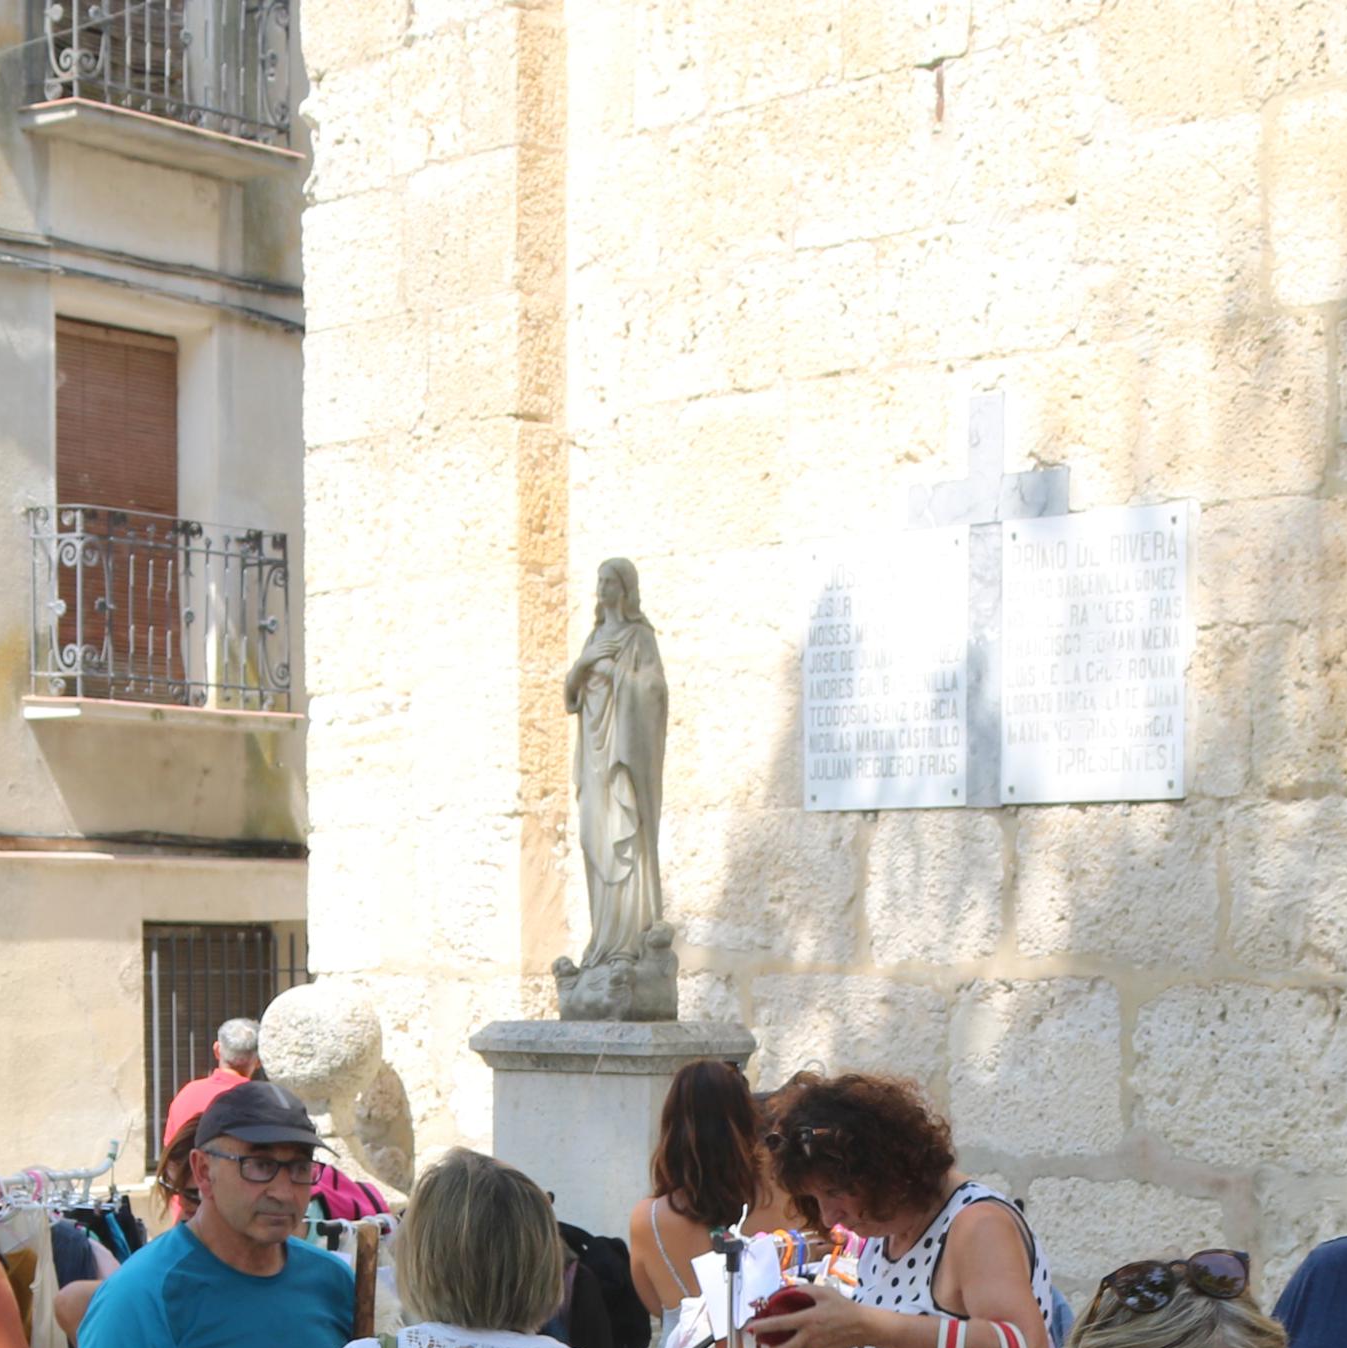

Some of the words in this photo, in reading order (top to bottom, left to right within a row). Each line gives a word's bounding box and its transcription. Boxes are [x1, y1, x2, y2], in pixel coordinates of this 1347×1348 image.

[1111, 530, 1178, 565] RIVERA
[1135, 567, 1177, 592] GOMEZ
[808, 623, 851, 647] MOISES
[1141, 625, 1180, 650] MENA
[809, 679, 853, 700] ANDRES
[809, 703, 869, 727] TEODOSIO
[913, 698, 959, 721] GARCIA
[856, 729, 895, 752] MARTIN
[899, 726, 960, 750] CASTRILLO
[809, 757, 852, 781] JULIAN
[856, 755, 914, 779] REGUERO
[918, 753, 958, 777] FRIAS
